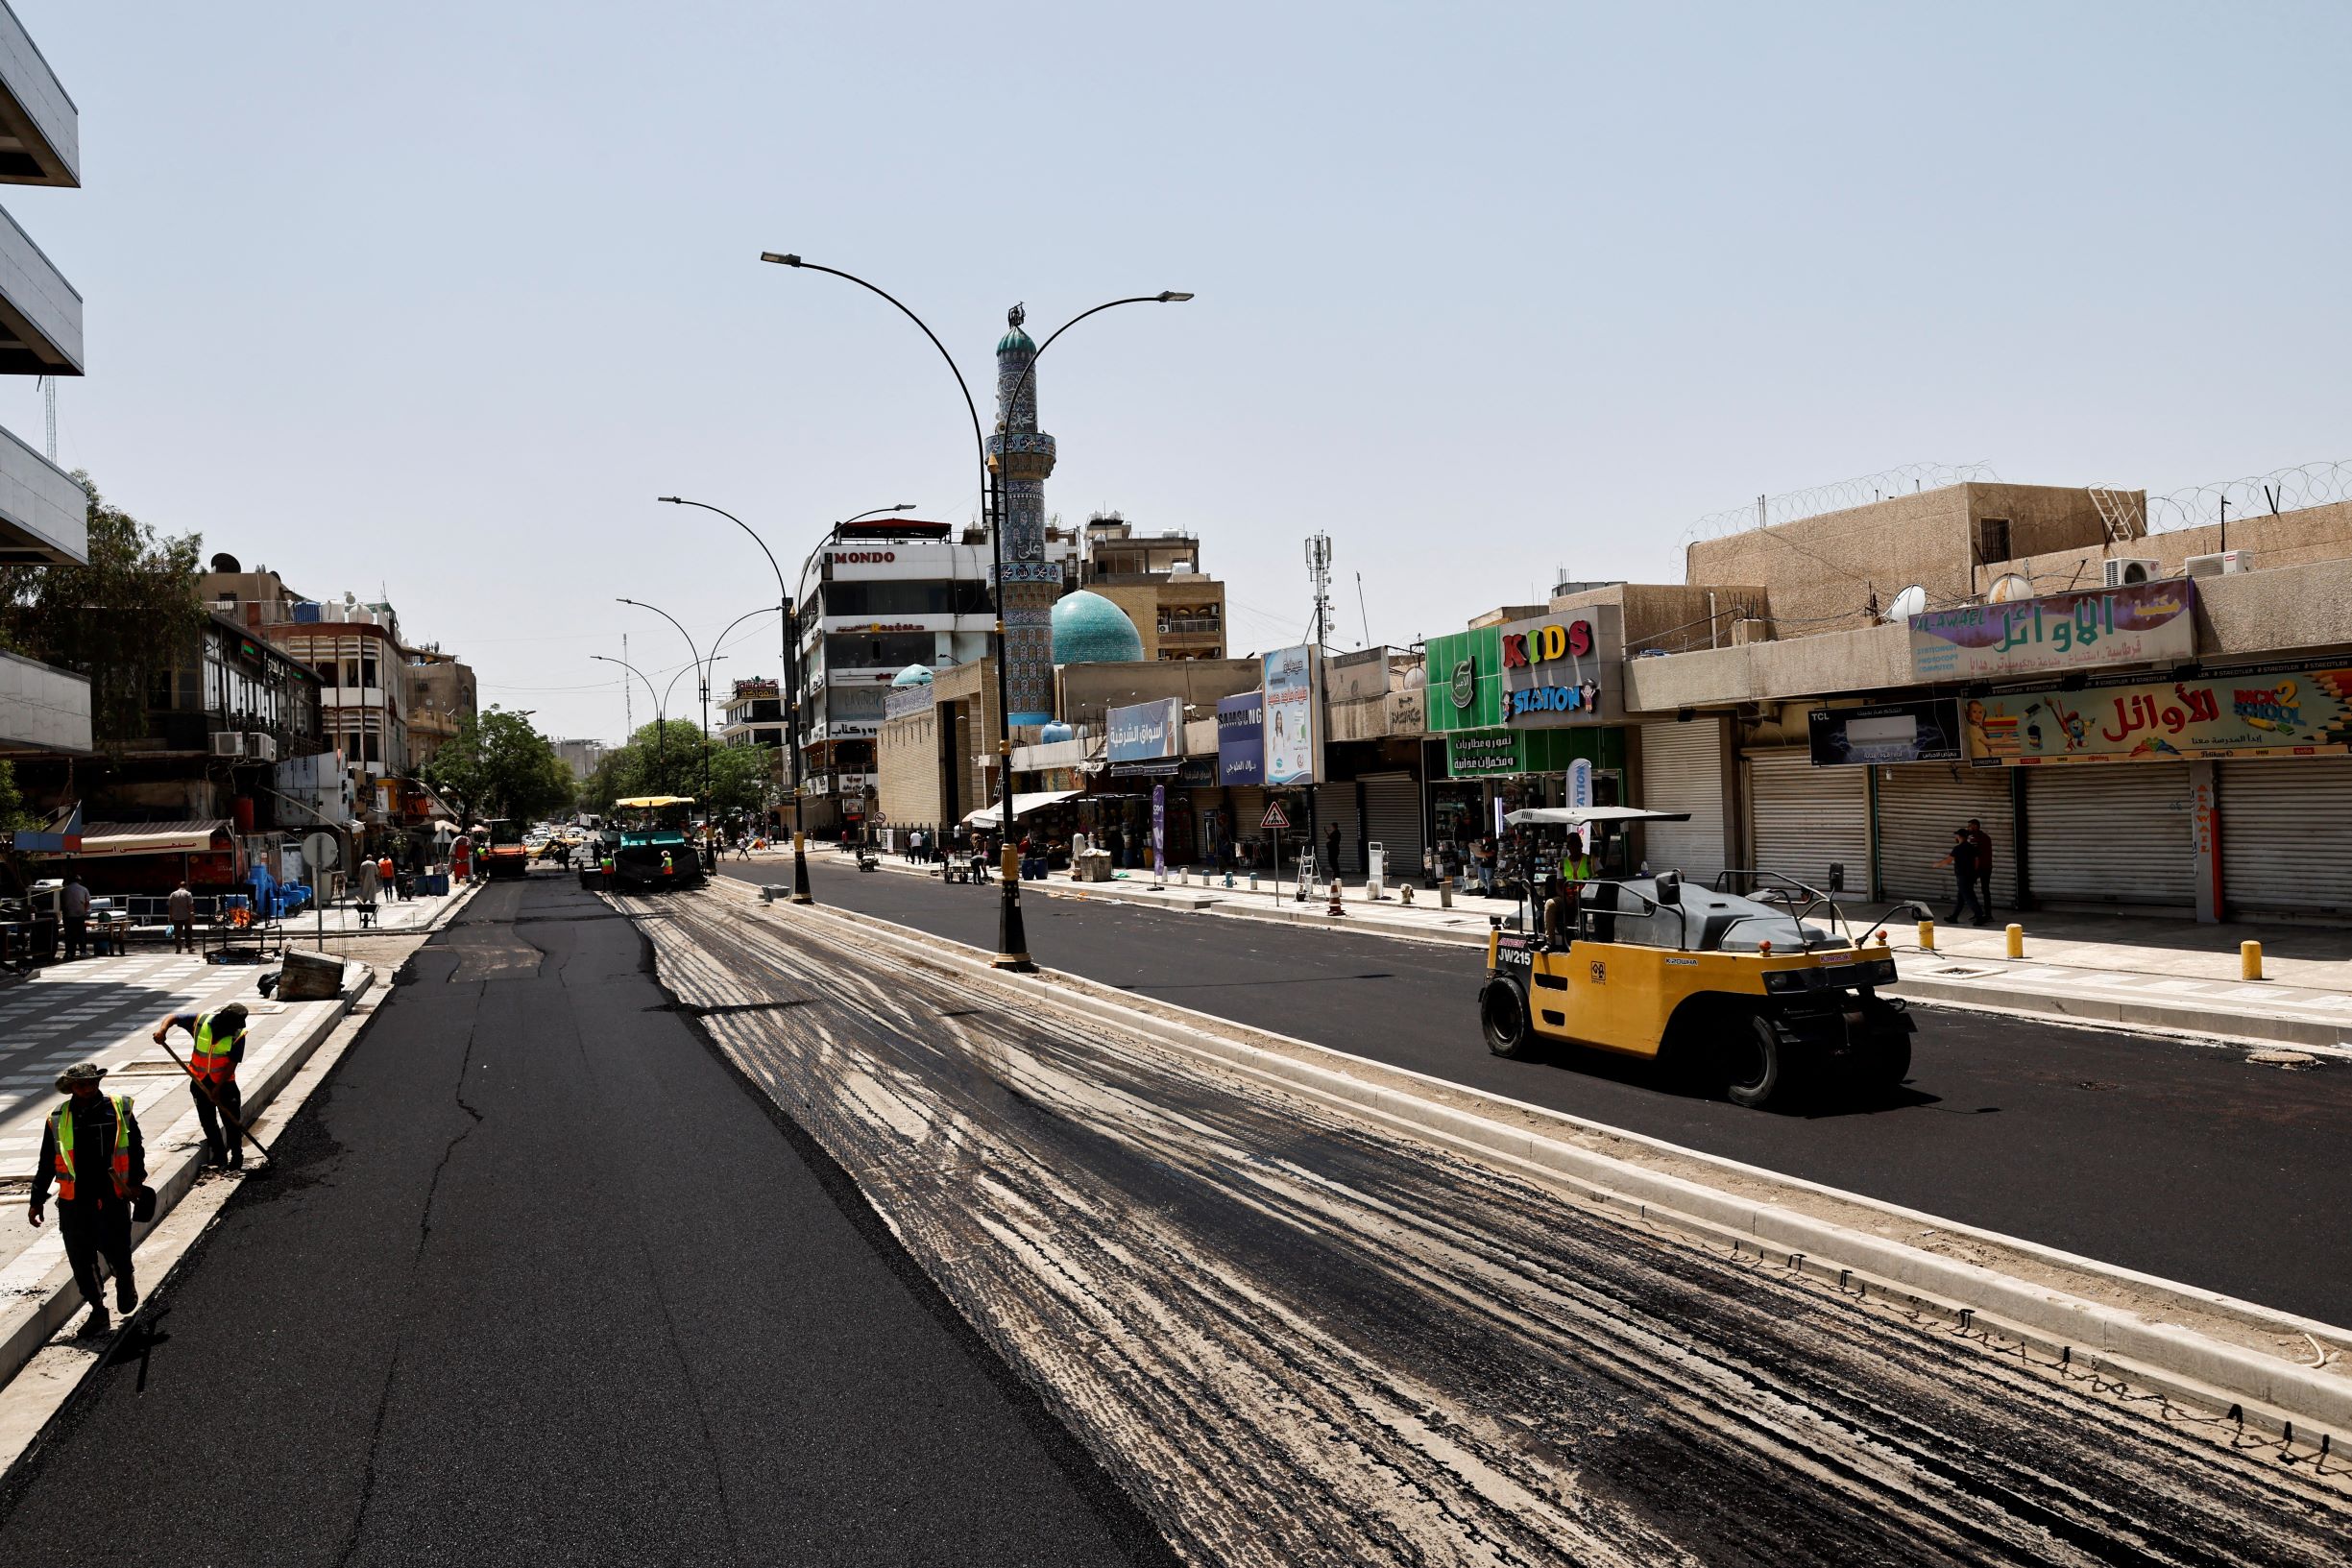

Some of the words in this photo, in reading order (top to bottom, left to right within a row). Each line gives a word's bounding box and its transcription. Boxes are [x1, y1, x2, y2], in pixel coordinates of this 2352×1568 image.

[834, 551, 895, 564] MONDO
[1915, 610, 1985, 631] AL-AWAEL
[1503, 620, 1592, 668] KIDS
[1514, 685, 1584, 715] STATION
[2275, 679, 2301, 708] 2
[1219, 708, 1262, 729] SAMSUNG
[1811, 712, 1830, 721] TCL
[2234, 702, 2307, 727] SCHOOL
[1110, 723, 1139, 747] الشرقية
[1139, 722, 1163, 744] اسواق
[2192, 736, 2210, 745] معنا
[2200, 750, 2225, 759] Pelikan
[1498, 948, 1531, 966] JW215
[1819, 953, 1852, 964] Kawasaki
